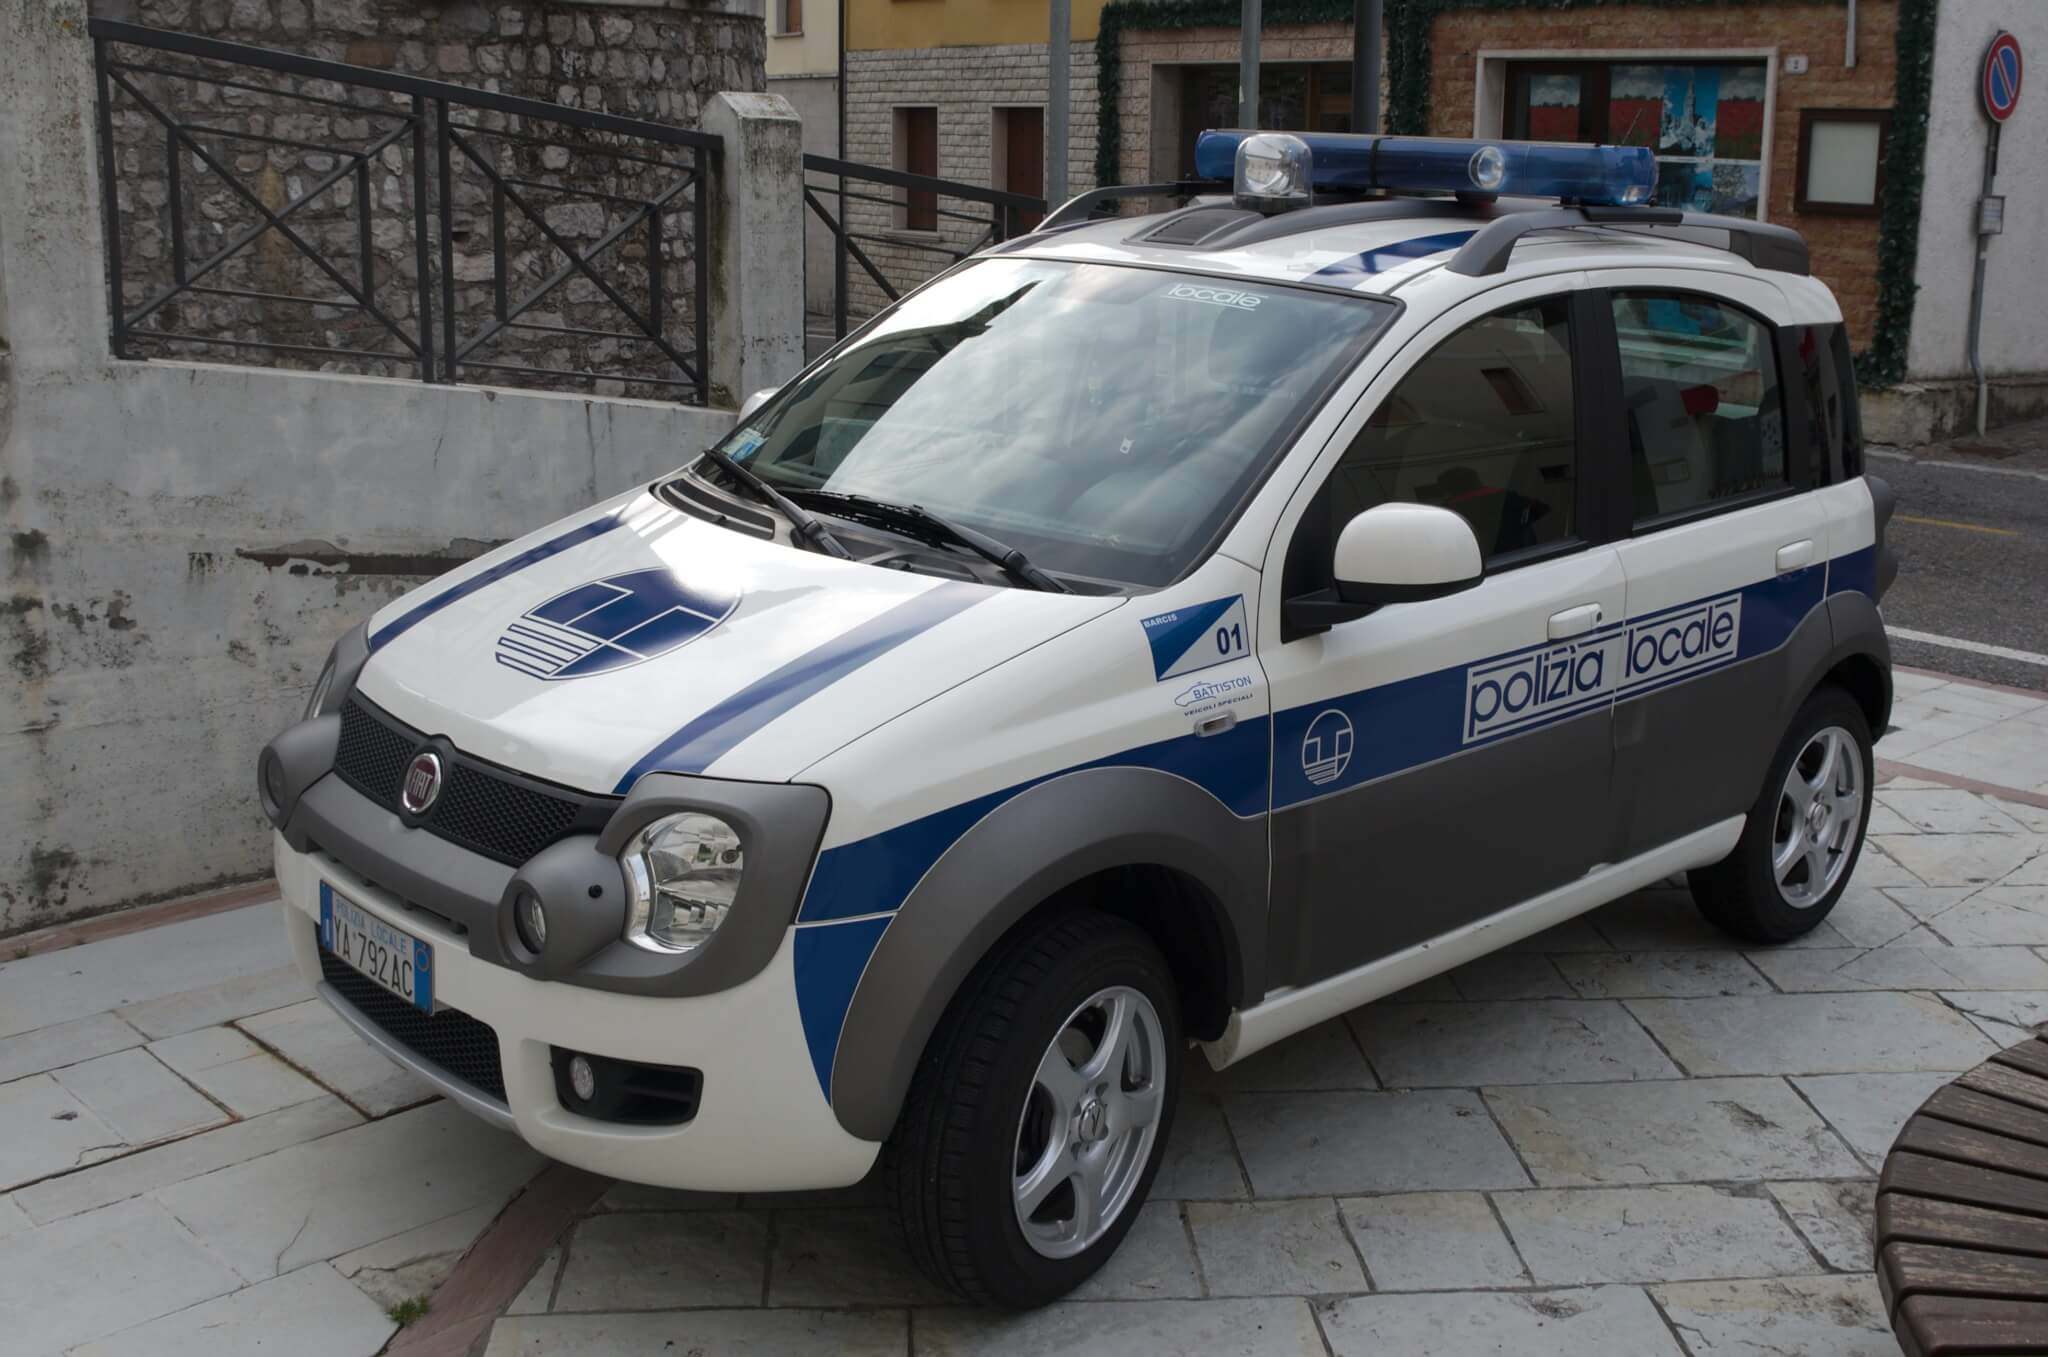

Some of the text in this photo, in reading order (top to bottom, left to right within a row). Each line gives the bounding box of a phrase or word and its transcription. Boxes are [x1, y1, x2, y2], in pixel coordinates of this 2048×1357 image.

[1168, 283, 1261, 307] locale
[1143, 614, 1177, 628] BARCIS
[1216, 623, 1242, 655] 01
[1625, 606, 1733, 678] locale
[1193, 675, 1252, 699] BATTISTON
[1184, 693, 1253, 716] VEICOLI SPECIALI
[409, 768, 433, 800] FIAT
[370, 922, 407, 953] LOCALE
